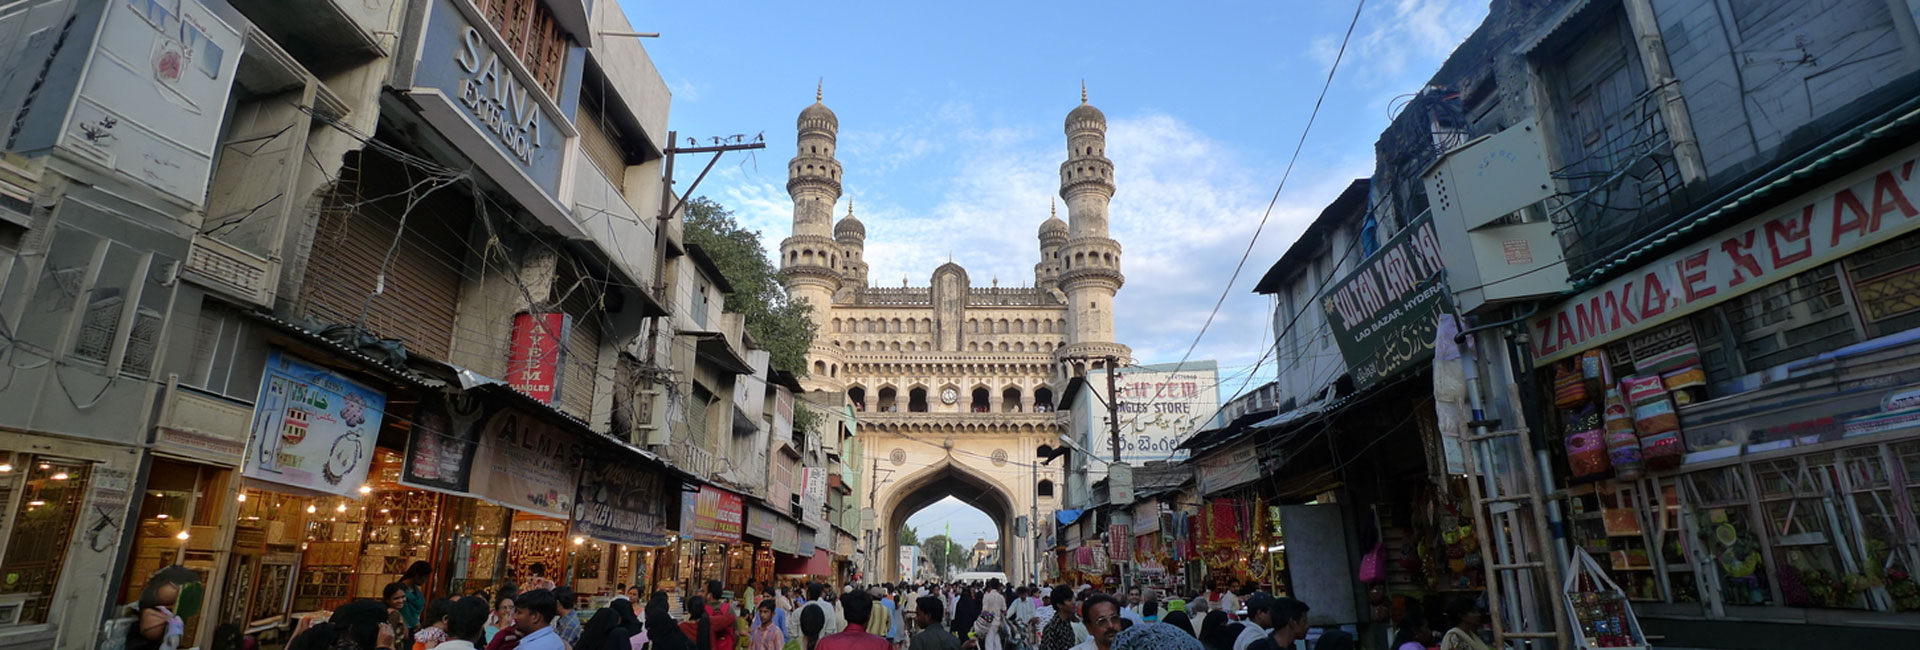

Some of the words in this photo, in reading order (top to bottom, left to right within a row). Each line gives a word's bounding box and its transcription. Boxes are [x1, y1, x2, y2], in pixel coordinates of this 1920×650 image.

[454, 26, 541, 148] SANA
[458, 78, 534, 166] EXTENSION
[1333, 268, 1385, 332] SULTAN
[1374, 243, 1418, 302] ZARI
[1354, 328, 1371, 342] LAD
[1107, 376, 1198, 399] areem
[1107, 402, 1148, 414] NGLES
[1154, 402, 1190, 414] STORE
[498, 413, 583, 466] ALMAS
